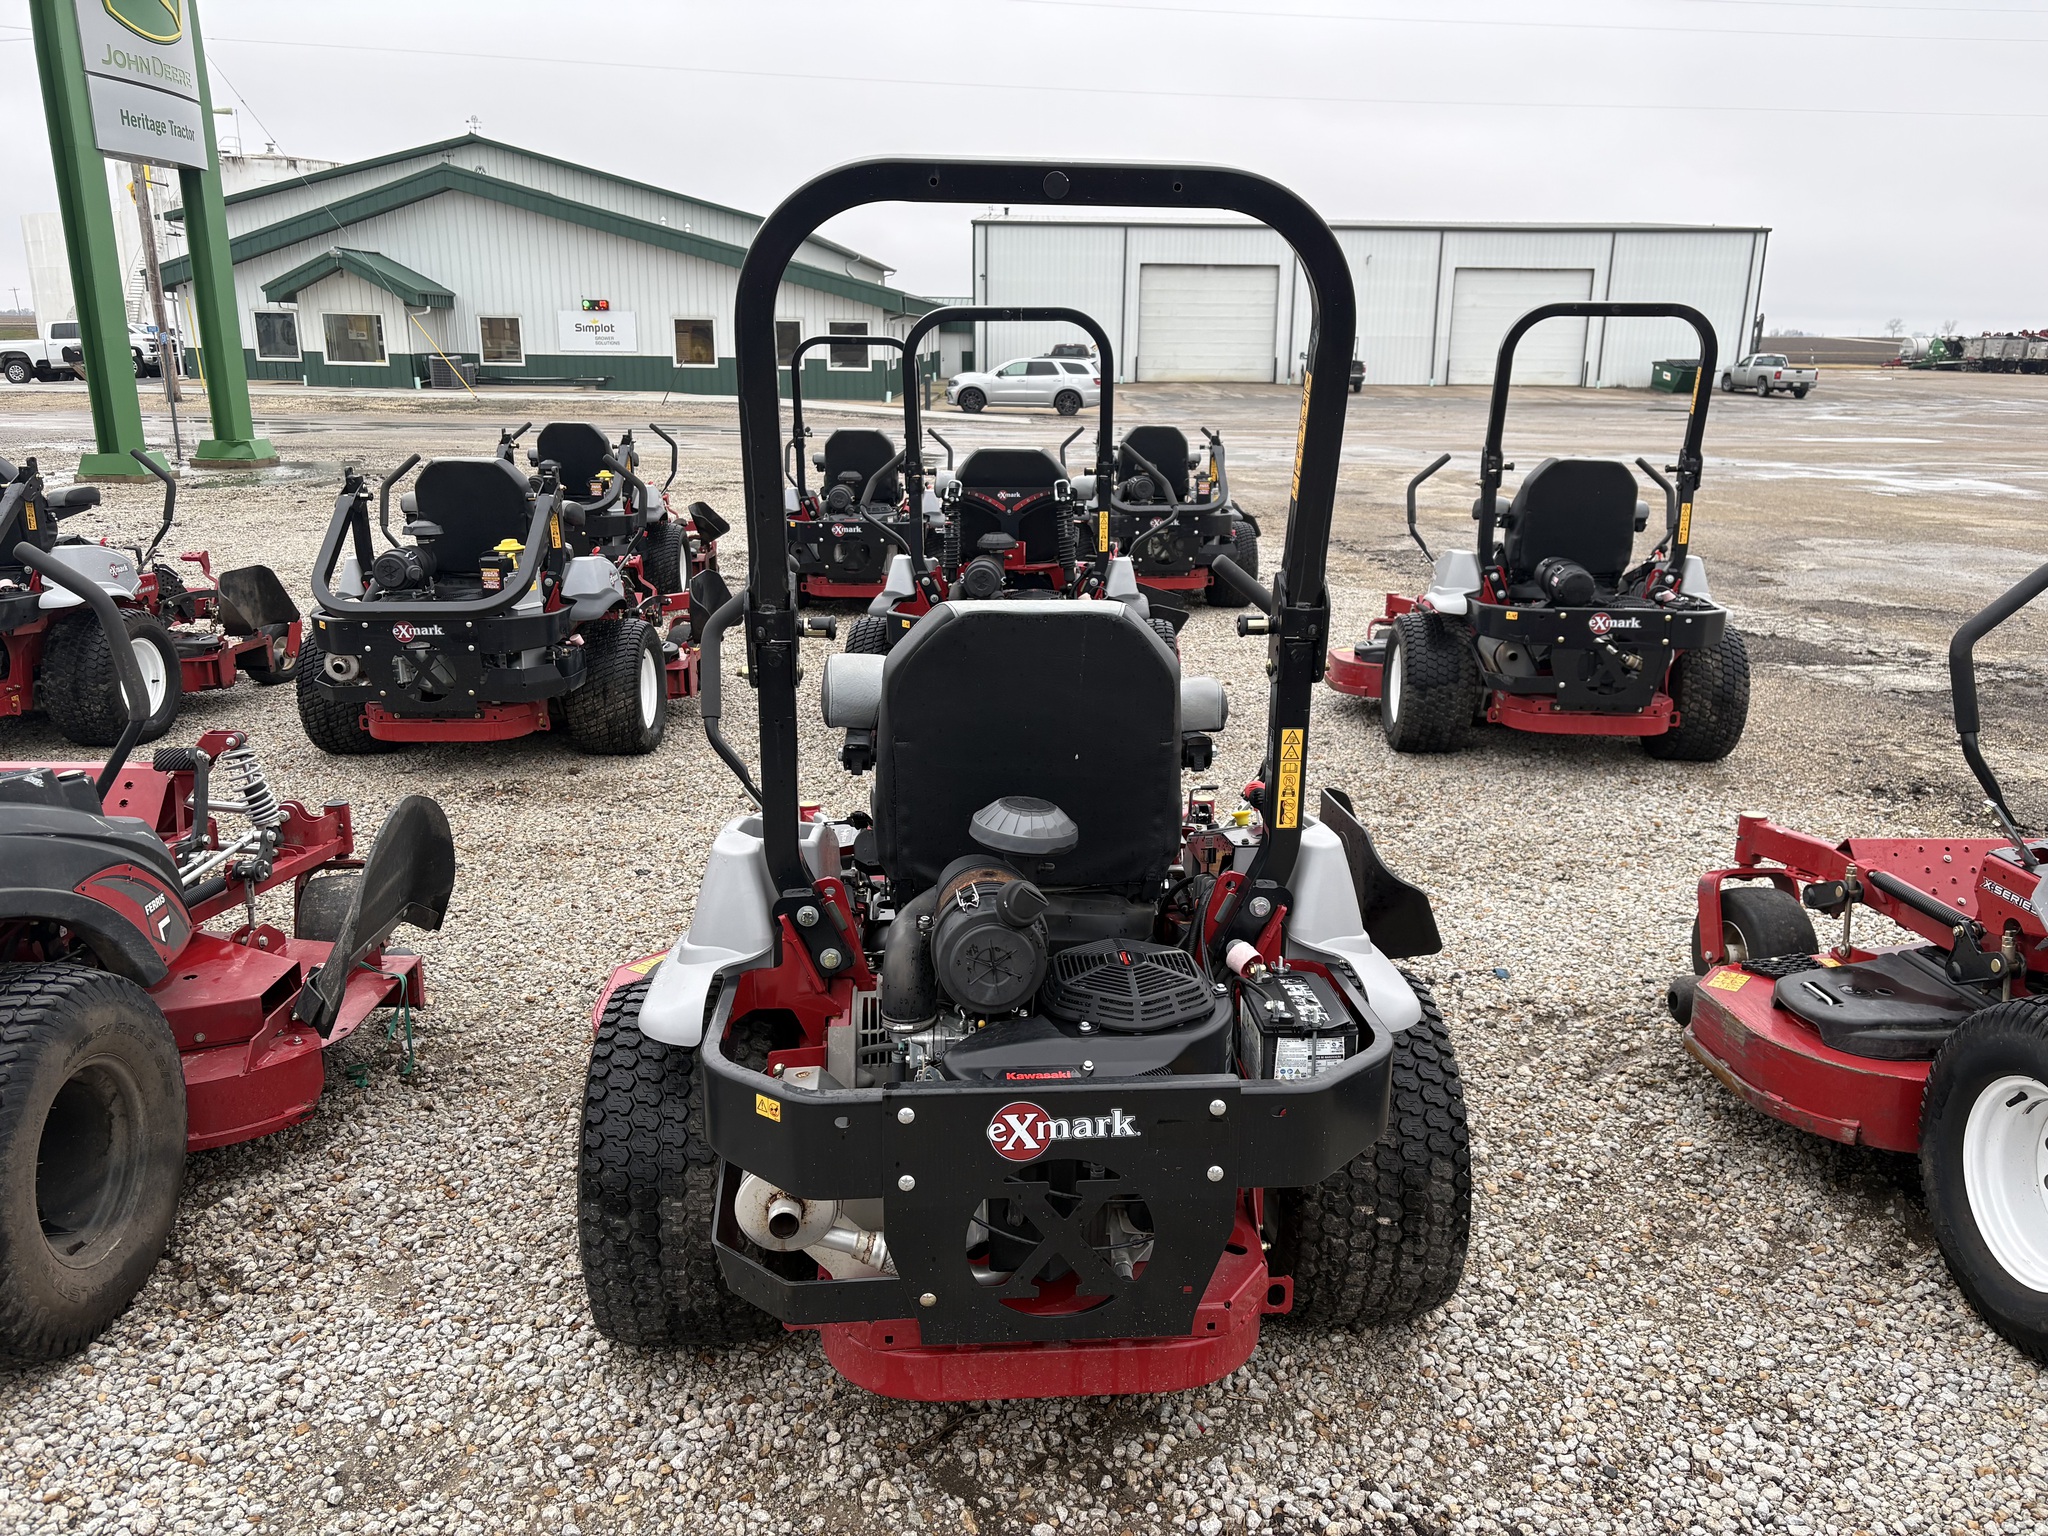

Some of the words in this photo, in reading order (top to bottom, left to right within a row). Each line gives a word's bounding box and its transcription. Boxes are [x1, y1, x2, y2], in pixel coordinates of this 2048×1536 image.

[102, 44, 150, 75] JOHN
[120, 109, 166, 136] Heritage
[168, 120, 195, 141] Tractor
[575, 323, 615, 335] Simplot
[997, 491, 1021, 499] eXmark
[832, 525, 862, 535] eXmark
[1589, 616, 1642, 631] eXmark
[392, 624, 445, 639] eXmark
[144, 893, 166, 916] FERRIS
[1006, 1071, 1072, 1080] Kawasaki
[987, 1106, 1142, 1152] eXmark
